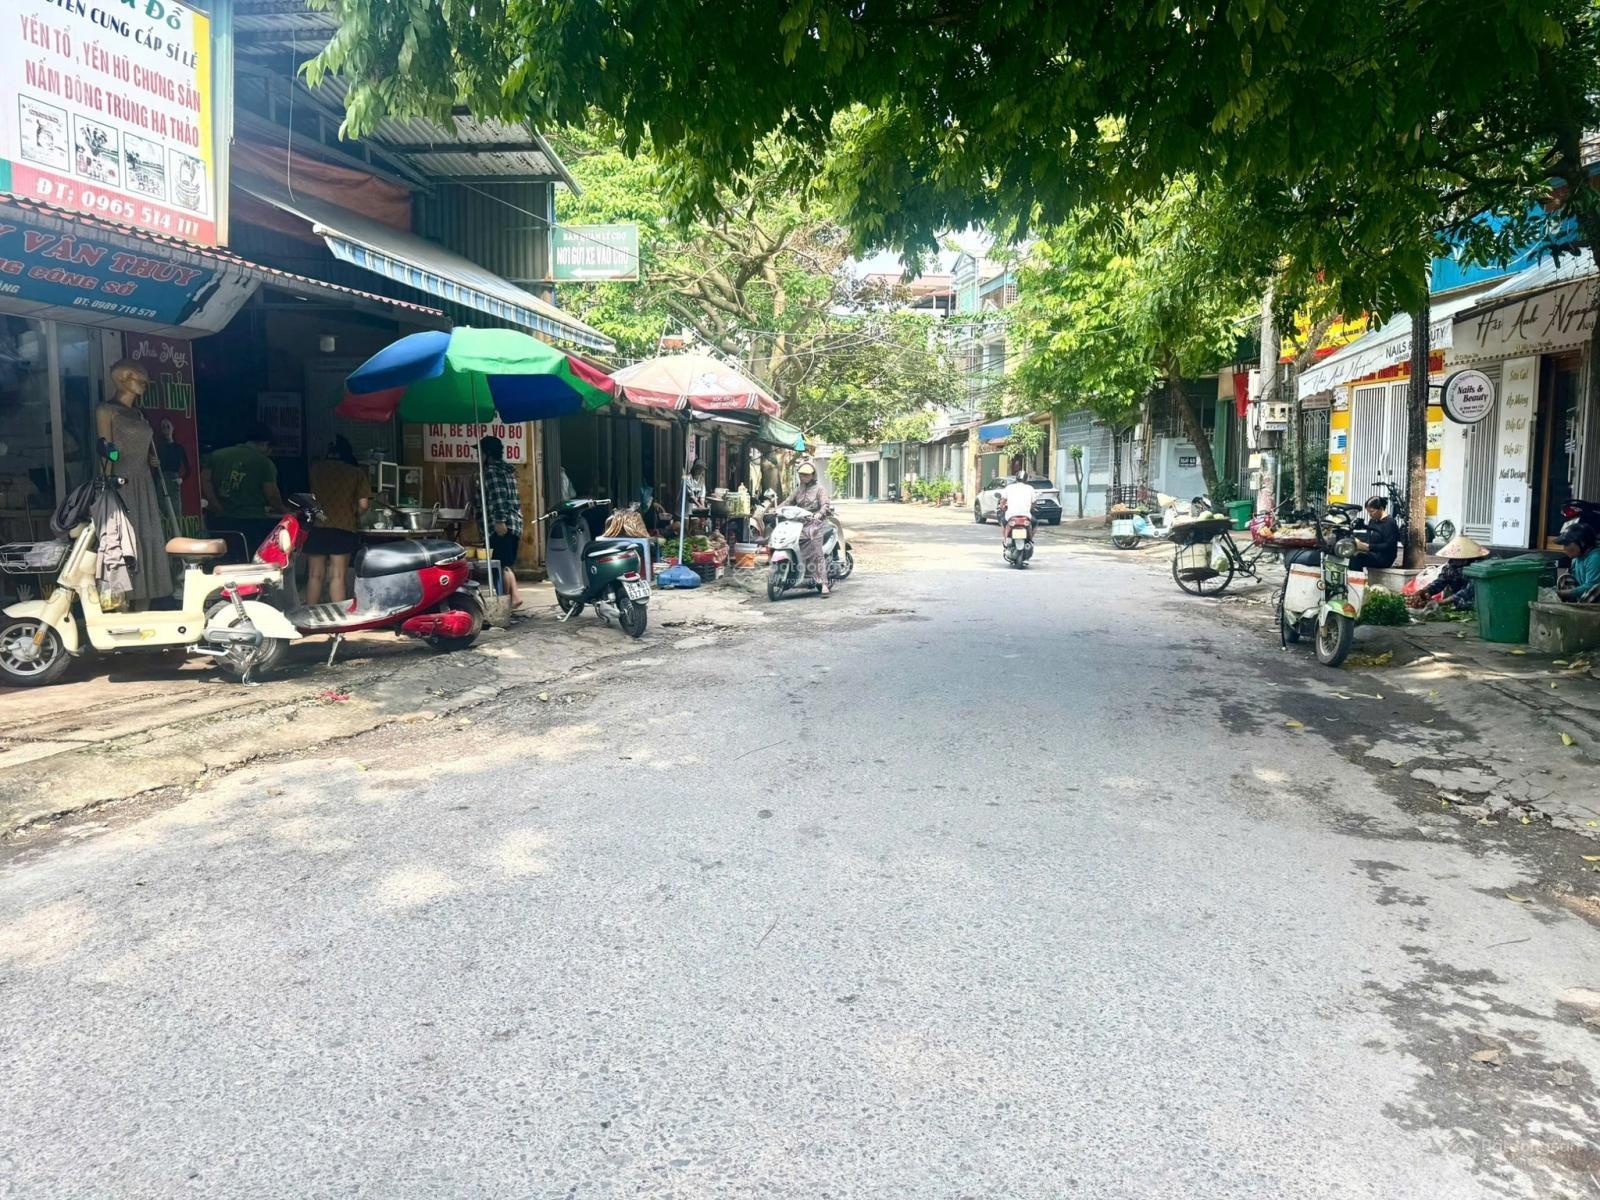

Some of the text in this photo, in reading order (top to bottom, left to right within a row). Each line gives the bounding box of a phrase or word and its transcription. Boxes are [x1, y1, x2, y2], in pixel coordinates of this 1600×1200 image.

[91, 6, 130, 37] CUNG
[135, 26, 163, 52] CẤP
[20, 12, 50, 51] YẾN
[83, 40, 110, 74] YẾN
[133, 64, 175, 102] CHƯNG
[25, 57, 61, 96] NẤM
[64, 75, 103, 112] ĐÔNG
[105, 92, 149, 129] TRÙNG
[151, 109, 168, 141] HẠ
[170, 116, 200, 149] THẢO
[36, 177, 74, 202] ĐT:
[81, 191, 135, 218] 0965
[140, 208, 171, 230] 514
[23, 230, 202, 287] VÂN THỦY
[27, 265, 99, 290] CÔNG
[1385, 342, 1408, 358] NAILS
[1457, 384, 1484, 395] Nails &
[1463, 393, 1489, 403] Beauty
[506, 442, 521, 459] BÒ
